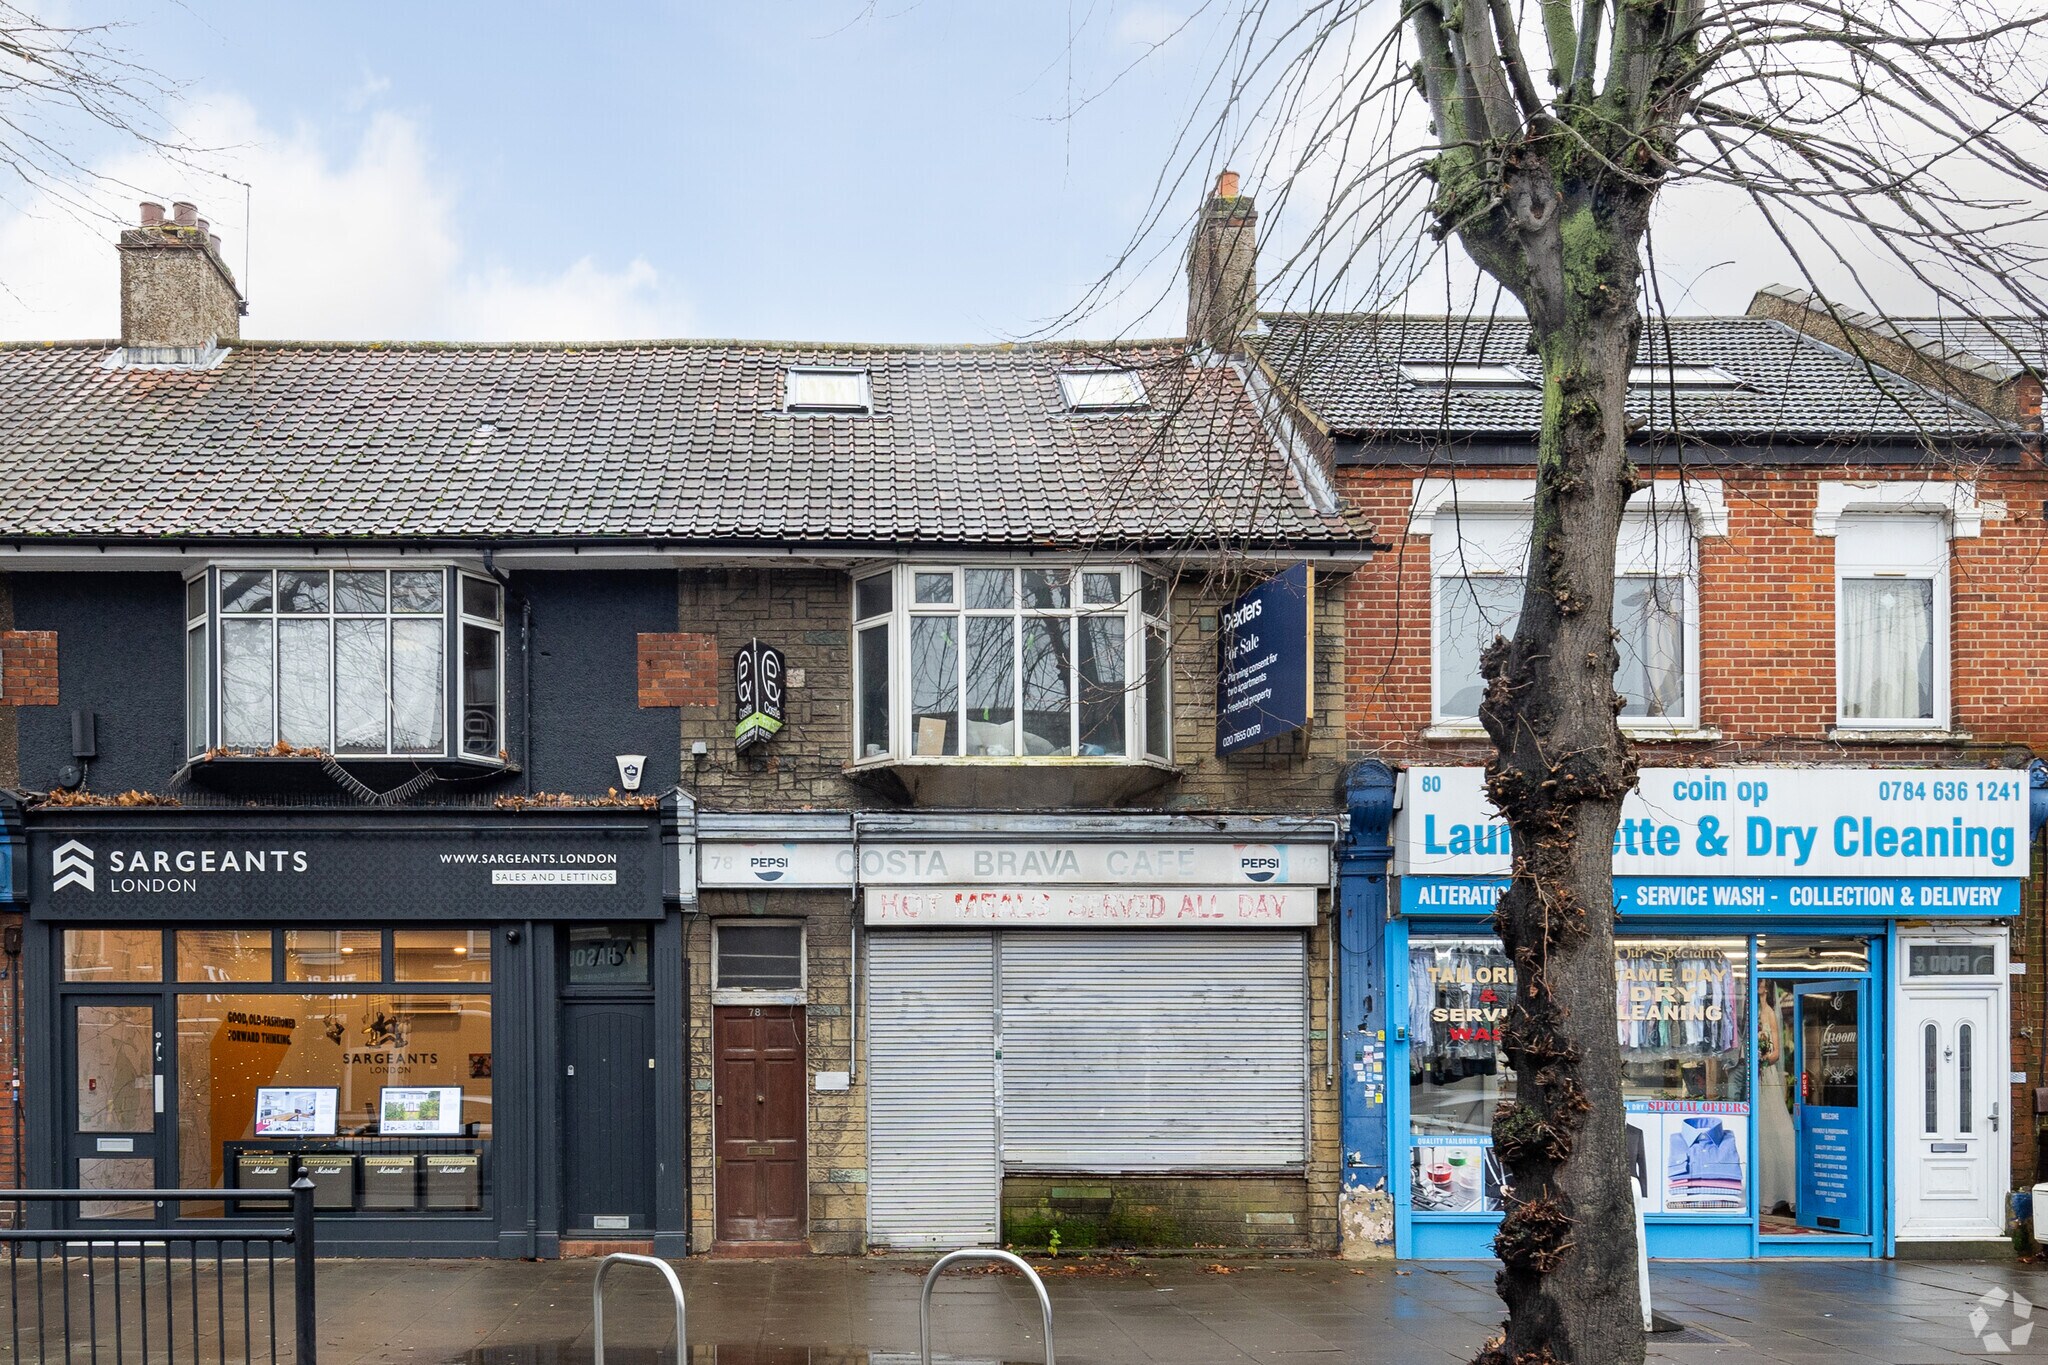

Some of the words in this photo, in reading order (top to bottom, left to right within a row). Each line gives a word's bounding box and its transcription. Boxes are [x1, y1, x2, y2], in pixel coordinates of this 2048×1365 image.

[1224, 598, 1262, 632] Dexters
[1240, 633, 1260, 655] Sale
[1249, 656, 1269, 674] consent
[1270, 653, 1278, 664] for
[1228, 686, 1238, 697] two
[1238, 673, 1267, 693] apartments
[1249, 687, 1272, 706] property
[1223, 734, 1234, 747] 020
[1234, 729, 1247, 743] 7655
[1247, 724, 1261, 739] 0079
[1422, 776, 1441, 793] 80
[1673, 775, 1727, 801] coin
[1737, 781, 1768, 807] op
[1879, 781, 1926, 801] 0784
[1933, 781, 1968, 801] 636
[1976, 781, 2020, 801] 1241
[1696, 815, 1730, 857] &
[1747, 816, 1818, 866] Dry
[1834, 815, 2015, 867] Cleaning
[109, 850, 308, 873] SARGEANTS
[439, 853, 617, 864] WWW.SARGEANTS.LONDON
[711, 856, 733, 870] 78
[750, 857, 789, 868] PEPSI
[835, 849, 949, 877] COSTA
[973, 849, 1082, 877] BRAVA
[1241, 857, 1280, 869] PEPSI
[495, 872, 527, 882] SALES
[531, 872, 556, 882] AND
[560, 872, 614, 882] LETTINGS
[110, 878, 197, 893] LONDON
[1636, 885, 1708, 907] SERVICE
[1712, 885, 1765, 907] WASH
[1789, 886, 1894, 907] COLLECTION
[1900, 886, 1915, 906] &
[1920, 886, 2002, 907] DELIVERY
[881, 892, 944, 919] HOT
[955, 892, 1051, 919] MEALS
[1067, 893, 1166, 919] SERVED
[1177, 893, 1225, 919] ALL
[1238, 893, 1288, 919] DAY
[1427, 967, 1515, 984] TAILORI
[1681, 968, 1728, 982] DAY
[1630, 986, 1698, 1003] DRY
[227, 1011, 248, 1027] GOOD,
[1432, 1008, 1508, 1022] SERVI
[1617, 1004, 1723, 1021] LEANING
[227, 1030, 260, 1043] FORWARD
[1449, 1027, 1502, 1041] WAS
[1823, 1023, 1857, 1044] Groom
[343, 1053, 438, 1064] SARGEANTS
[369, 1066, 411, 1074] LONDON
[1648, 1101, 1700, 1112] SPECIAL
[1702, 1101, 1750, 1114] OFFERS
[1417, 1137, 1444, 1145] QUALITY
[1446, 1137, 1478, 1145] TAILORING
[251, 1166, 278, 1175] Marshall
[314, 1166, 342, 1175] Marshall
[376, 1166, 404, 1175] Marshall
[439, 1166, 467, 1175] Marshall
